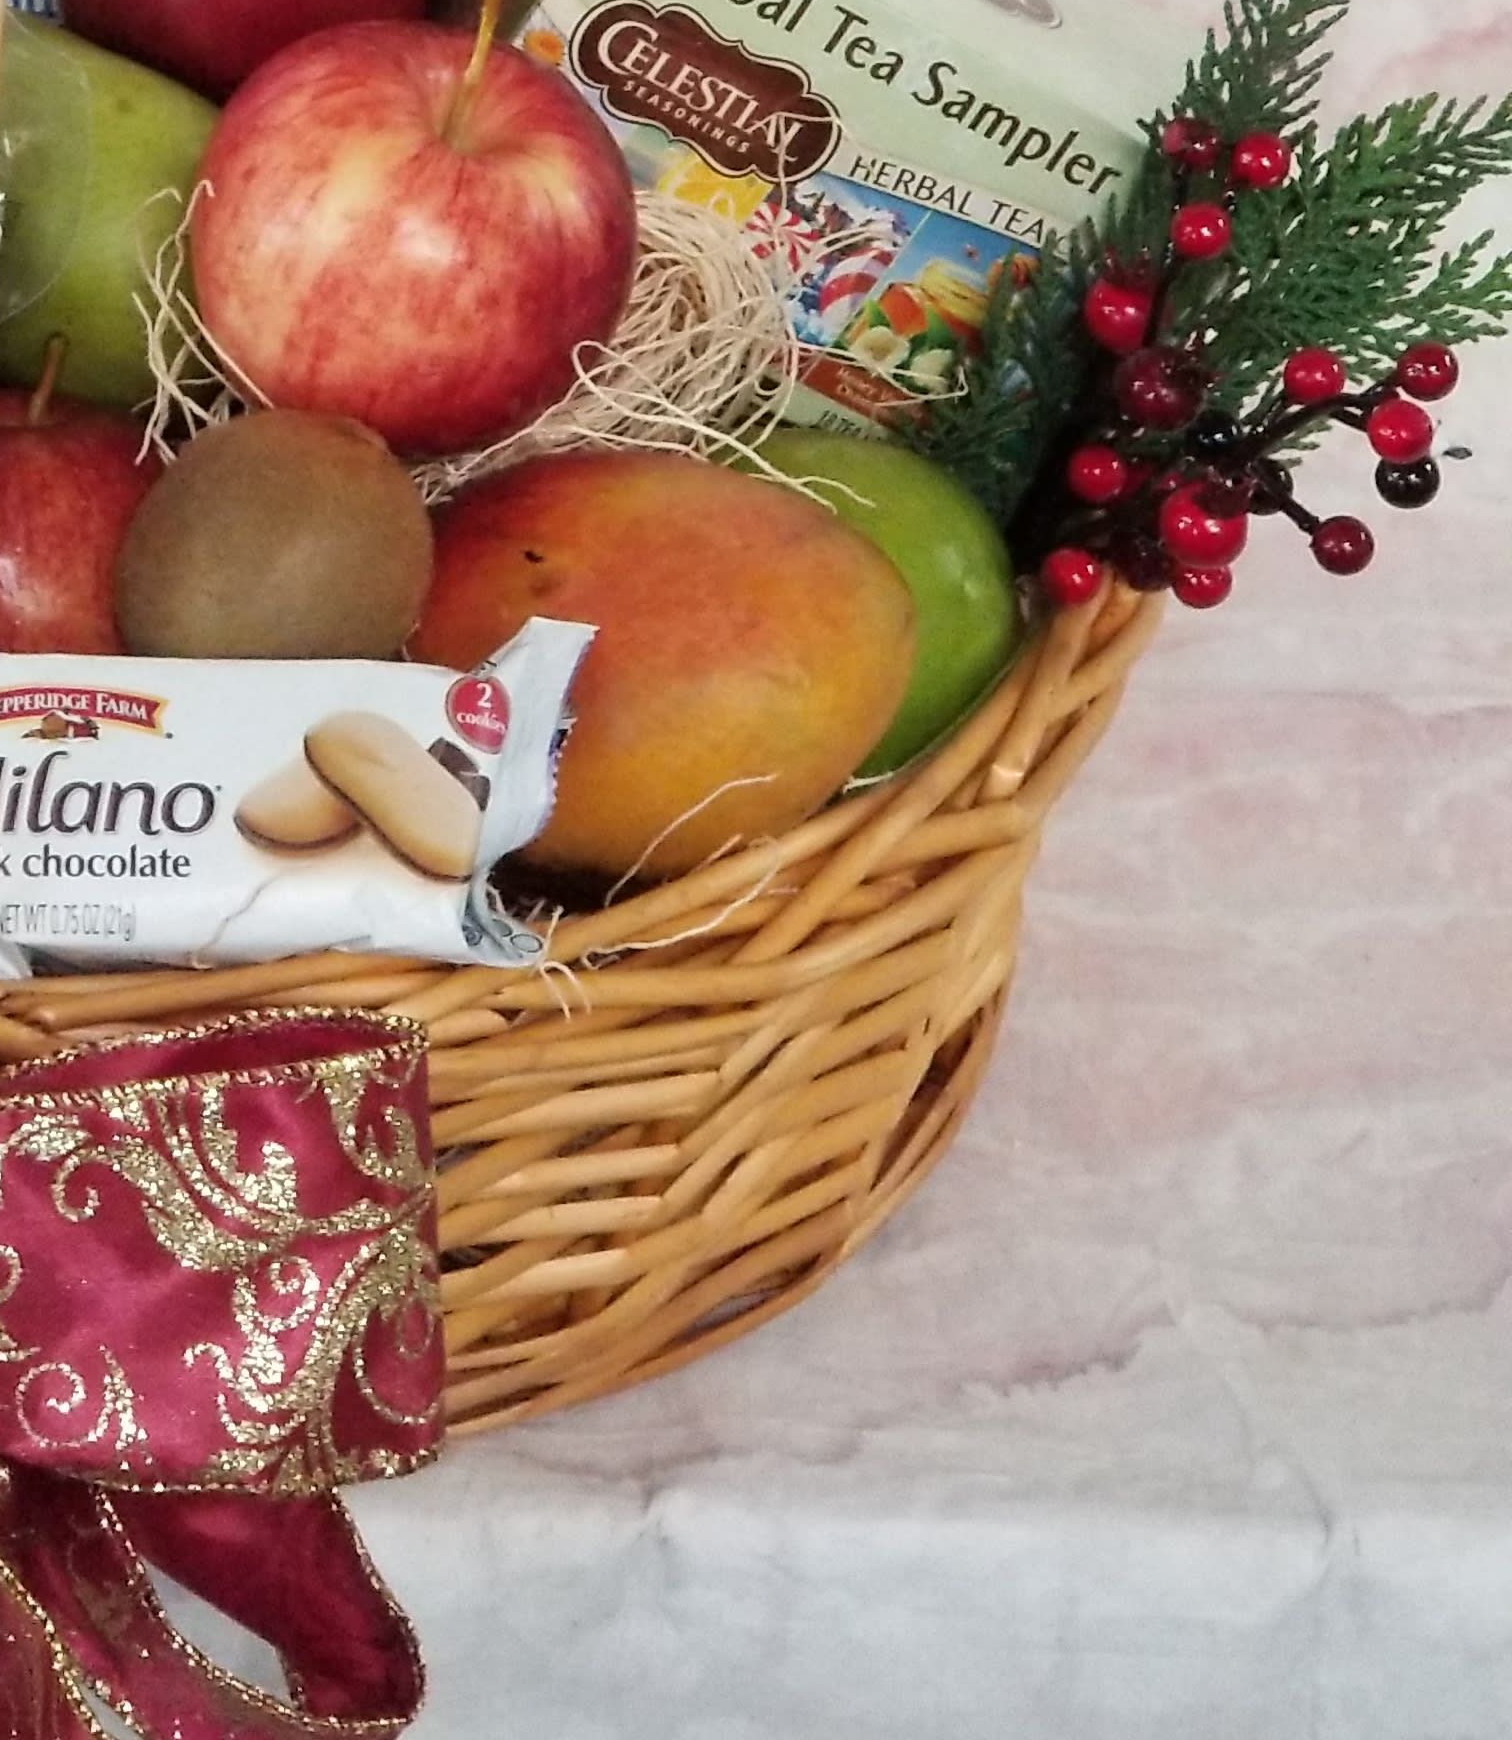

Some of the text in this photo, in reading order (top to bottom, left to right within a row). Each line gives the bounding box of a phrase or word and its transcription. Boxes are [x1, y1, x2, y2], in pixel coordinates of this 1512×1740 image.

[598, 20, 803, 162] CELESTIAL
[823, 5, 905, 86] Tea
[912, 59, 1124, 195] Sampler
[623, 80, 751, 153] SEASONINGS
[849, 155, 974, 217] HERBAL
[95, 692, 148, 721] FARM
[476, 682, 493, 709] 2
[22, 844, 192, 878] chocolate
[24, 904, 47, 935] WT
